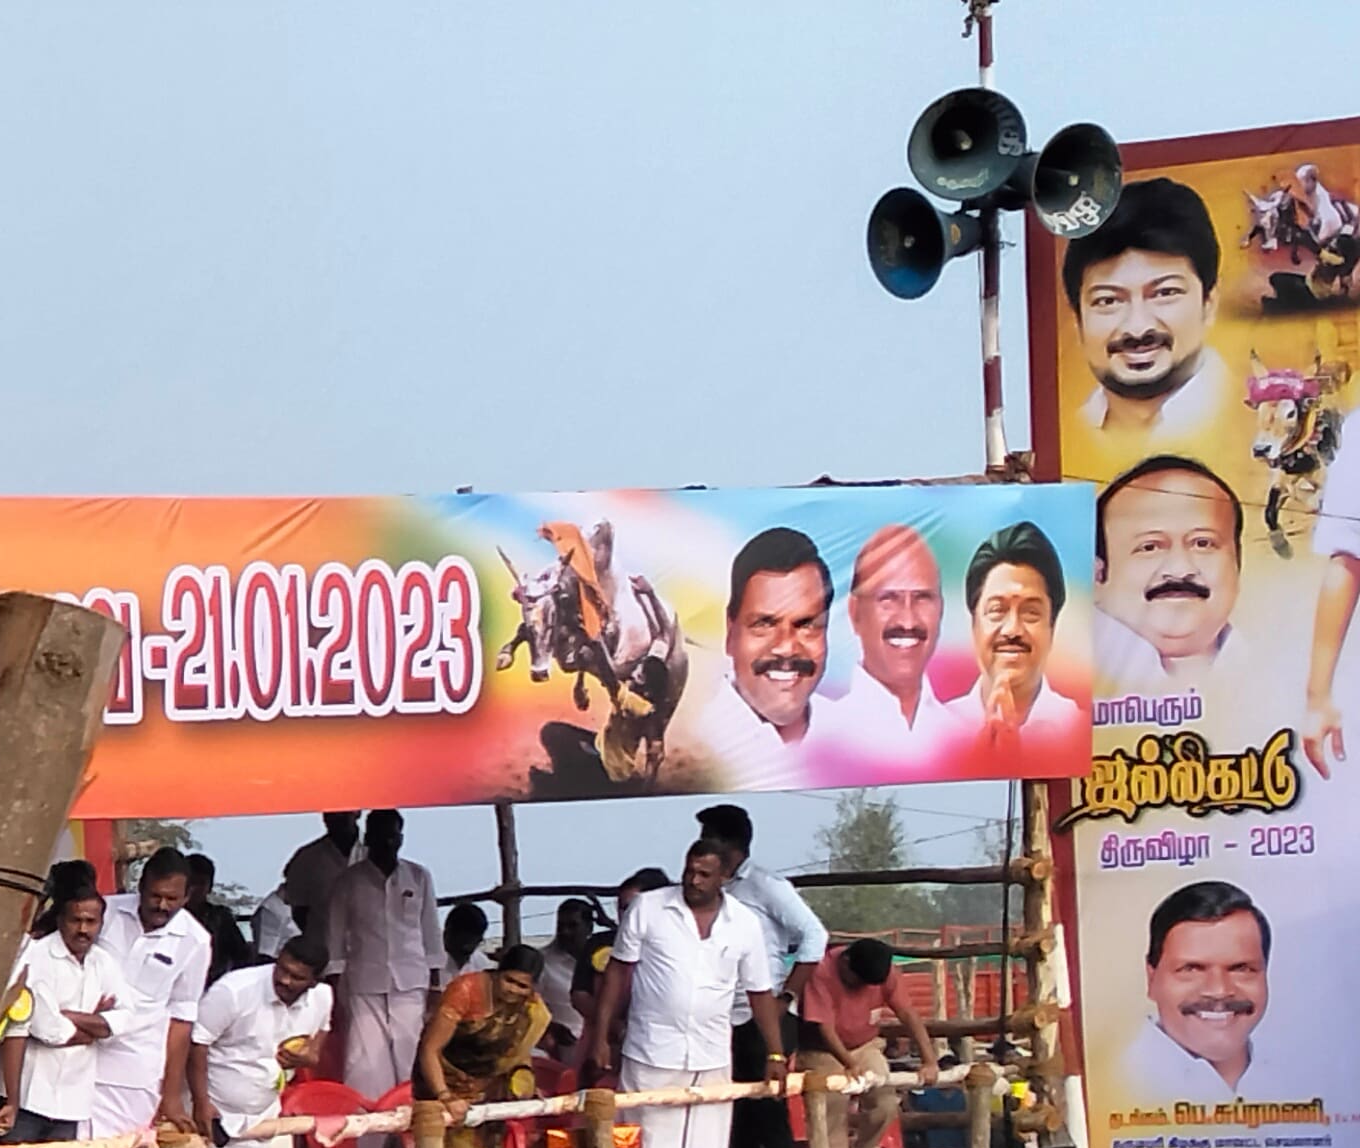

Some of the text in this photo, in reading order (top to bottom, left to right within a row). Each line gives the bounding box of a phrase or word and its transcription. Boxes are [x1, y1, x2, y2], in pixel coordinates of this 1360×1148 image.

[1092, 688, 1203, 726] மாபெரும்
[1101, 831, 1211, 869] திருவிழா
[1250, 825, 1315, 857] 2023
